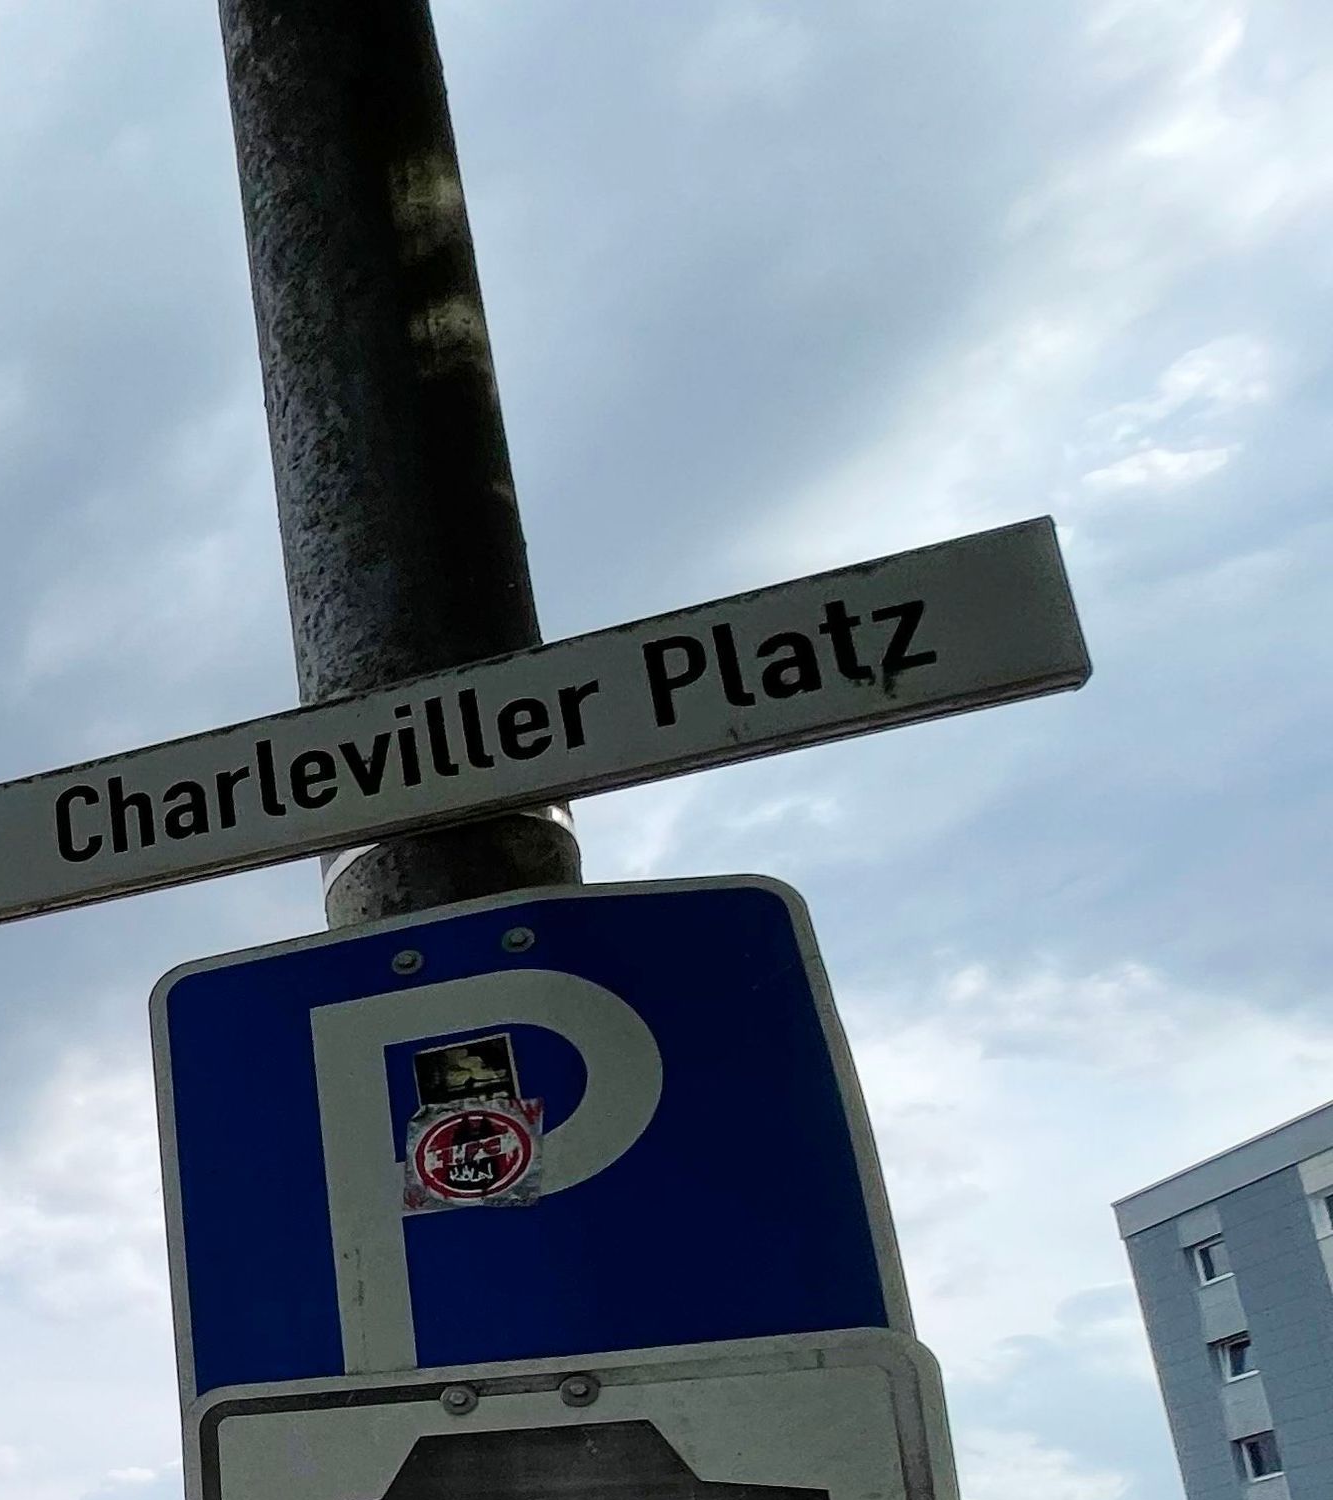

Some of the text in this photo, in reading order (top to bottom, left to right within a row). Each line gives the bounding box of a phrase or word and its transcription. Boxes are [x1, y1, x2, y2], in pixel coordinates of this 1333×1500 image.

[55, 596, 938, 863] Charleviller Platz
[310, 968, 663, 1376] P
